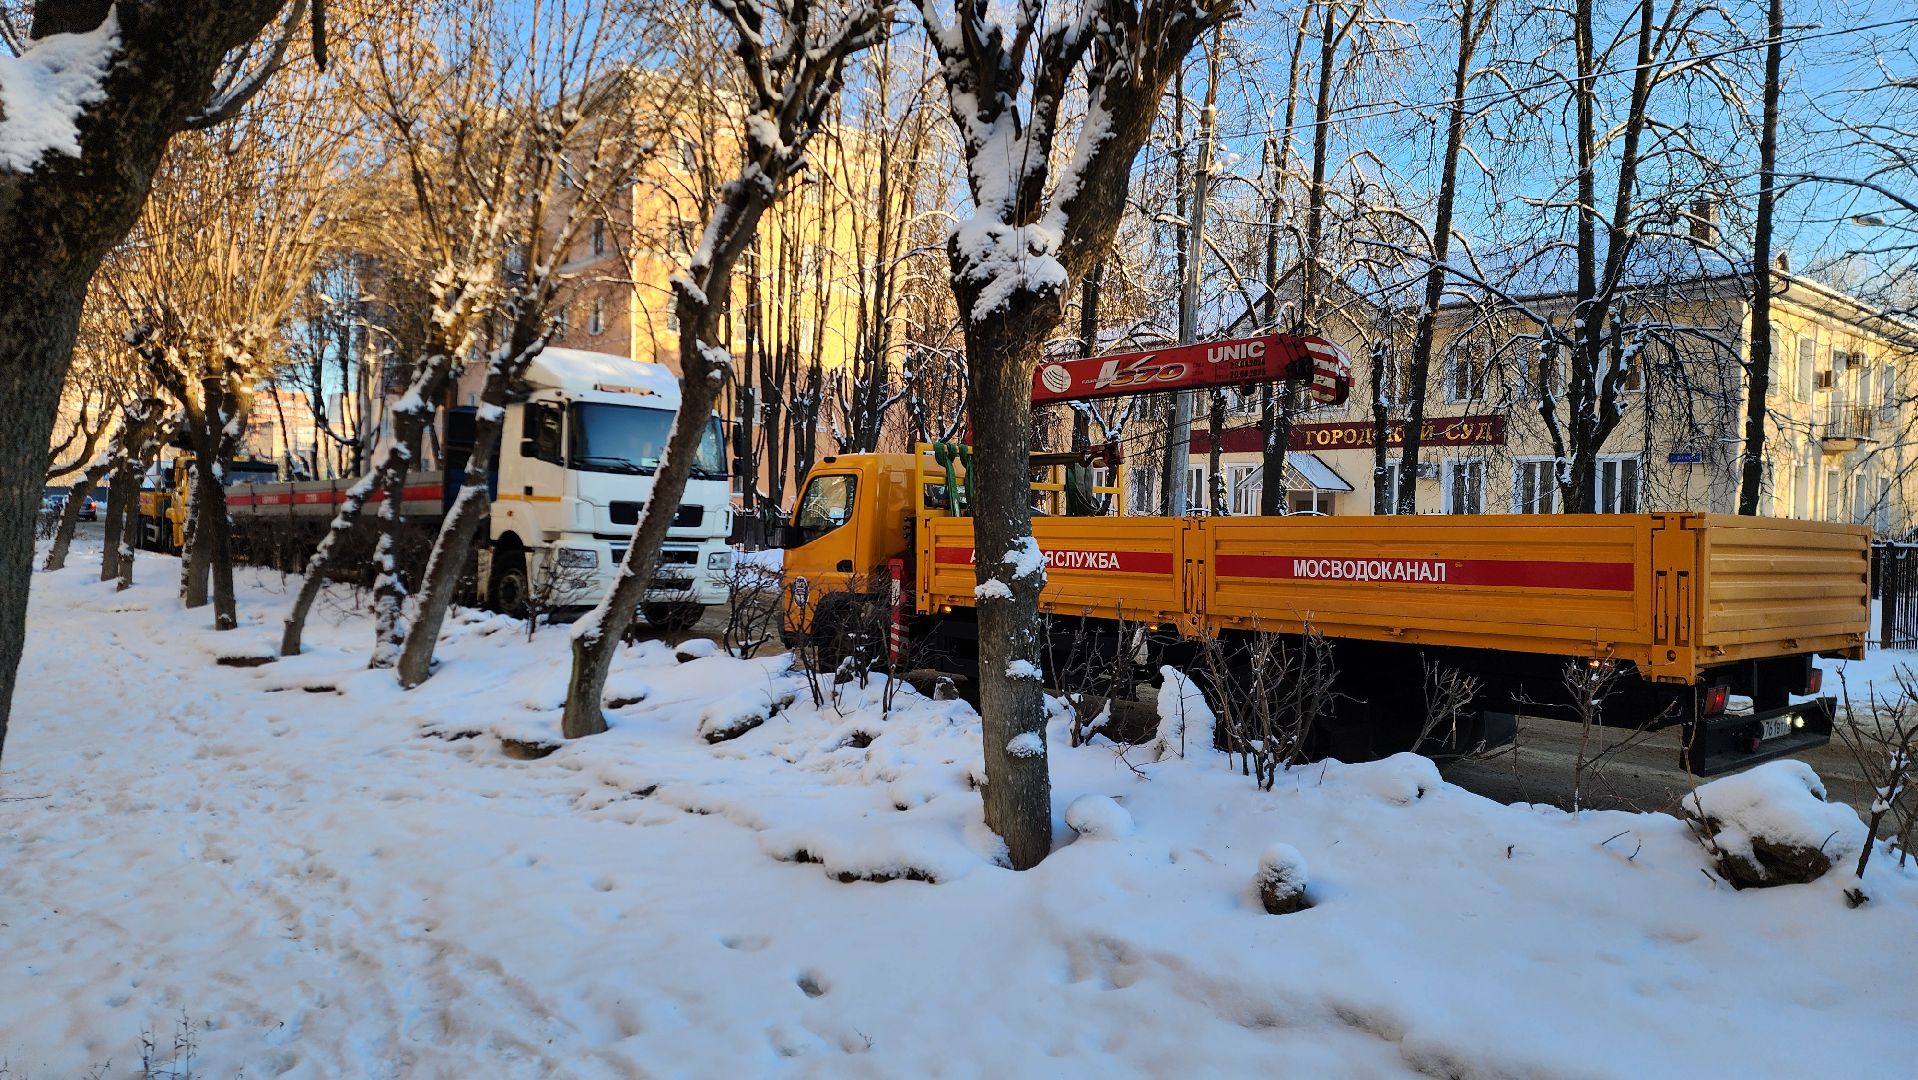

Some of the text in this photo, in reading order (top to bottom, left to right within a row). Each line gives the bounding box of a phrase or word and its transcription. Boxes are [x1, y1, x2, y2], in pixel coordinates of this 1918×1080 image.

[1207, 341, 1266, 363] UNIC
[1305, 420, 1493, 446] ГОРОДКЙ СУД
[1293, 559, 1447, 582] МОСВОДОКАНАЛ
